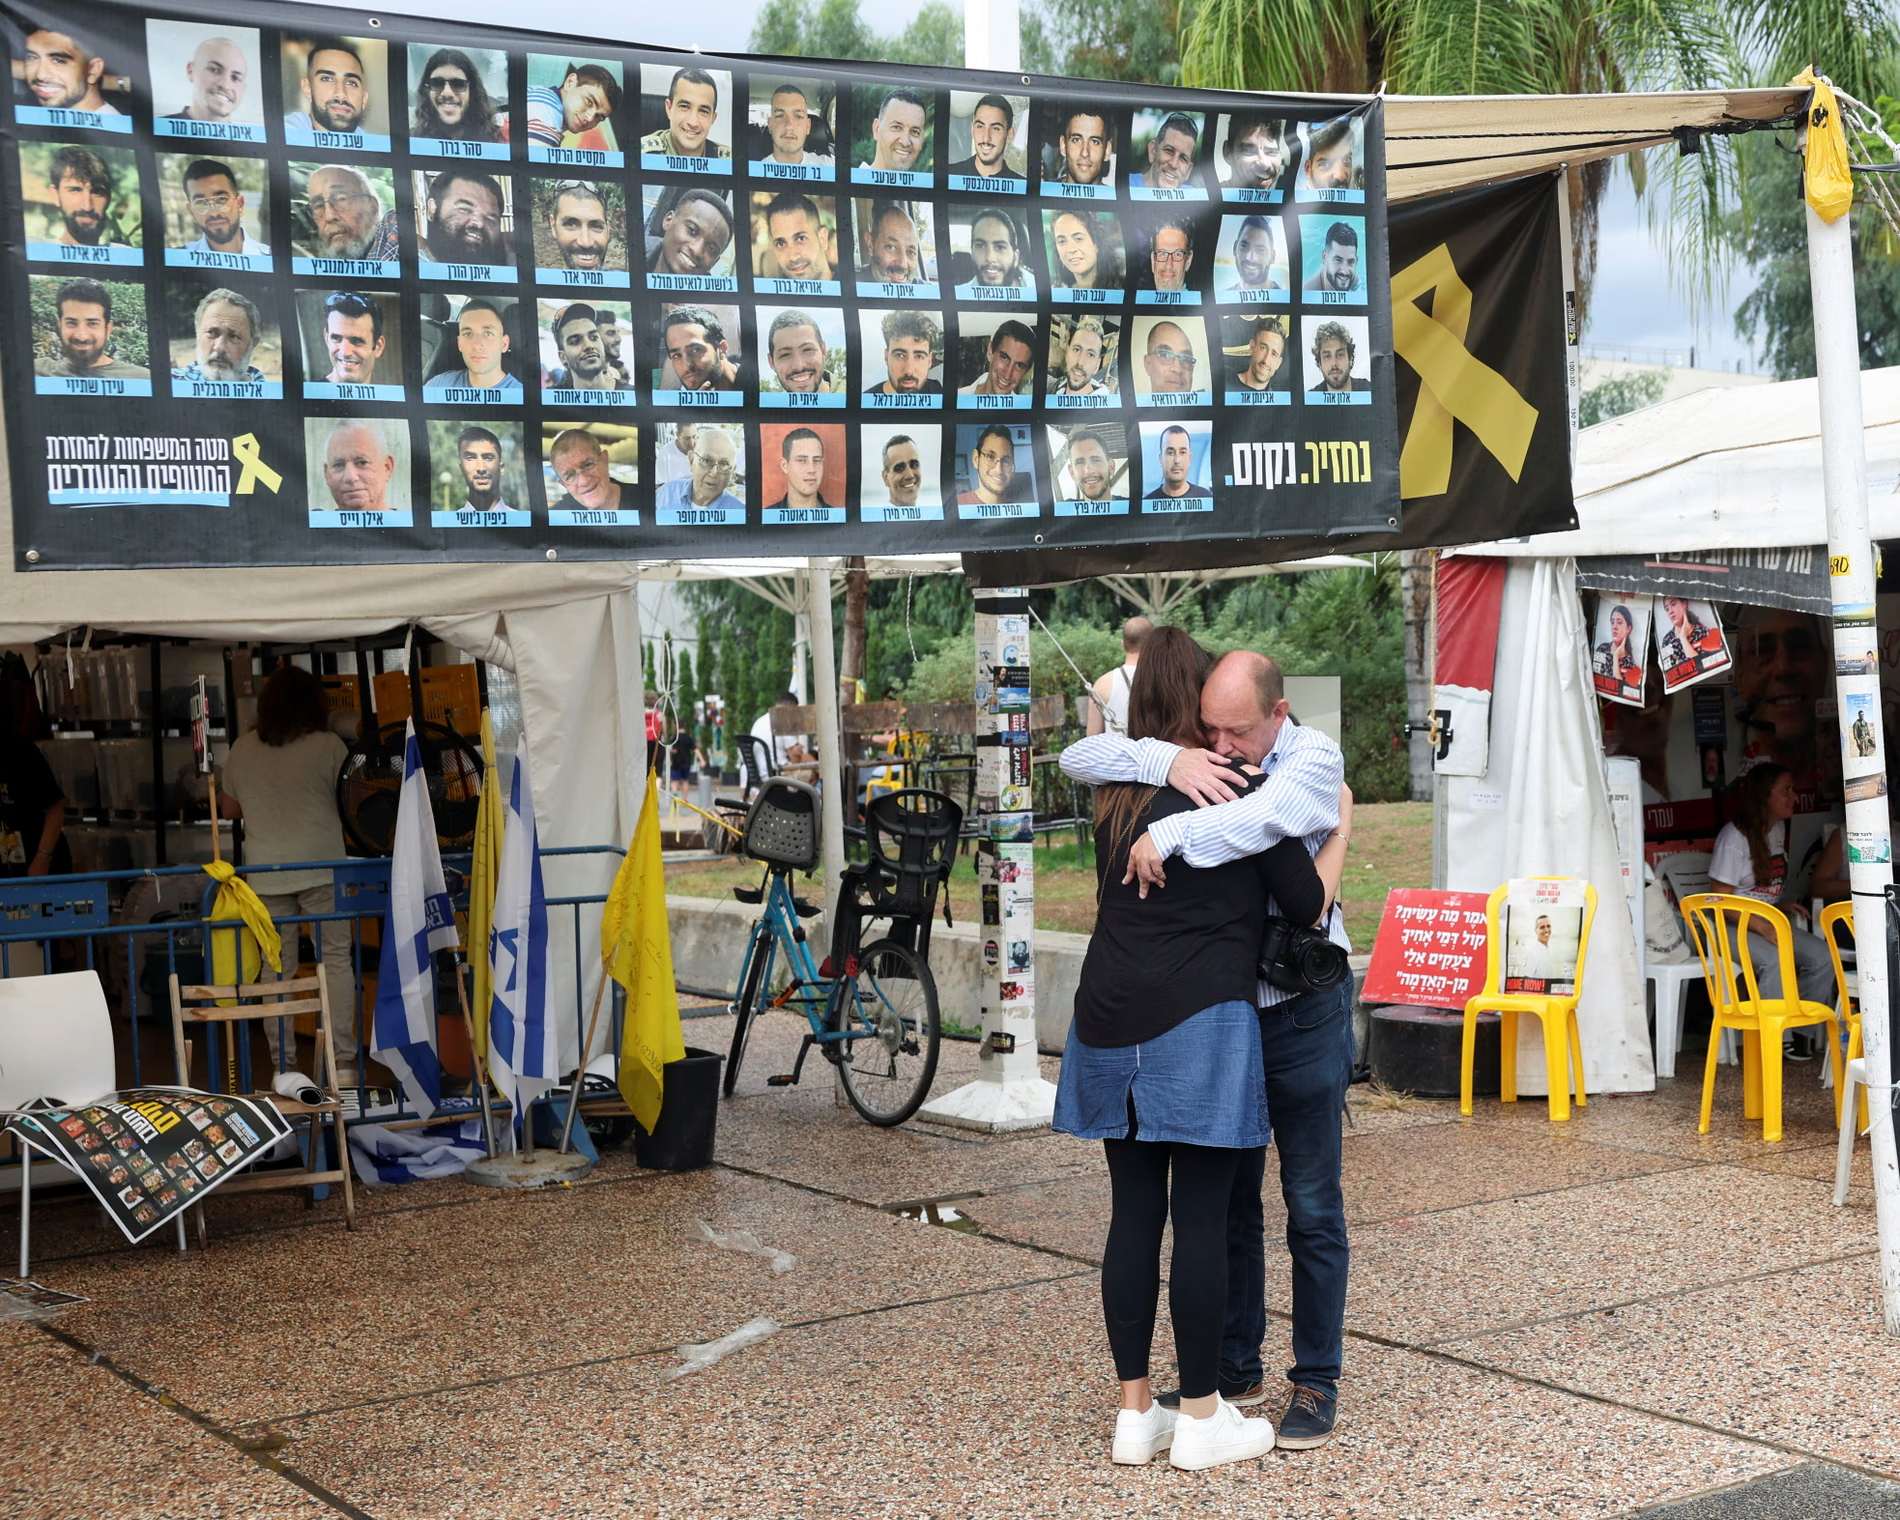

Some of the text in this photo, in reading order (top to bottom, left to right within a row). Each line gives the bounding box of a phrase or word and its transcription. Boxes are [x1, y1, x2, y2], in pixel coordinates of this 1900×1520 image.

[47, 109, 103, 128] אביתר דוד
[169, 120, 252, 140] איתן אברהם מור
[313, 131, 363, 149] שגב כלפון
[439, 141, 482, 157] סהר ברוך
[547, 148, 605, 165] מקסים הרקין
[666, 155, 708, 172] אסף חממי
[763, 163, 821, 180] בר קופרשטיין
[872, 171, 914, 186] יוסי שרעבי
[963, 177, 1014, 192] רום ברסלבסקי
[1061, 184, 1094, 197] עוז דניאל
[1319, 190, 1346, 202] דוד קוניו
[60, 245, 110, 262] גיא אילוז
[190, 250, 250, 270] רן רני גואילי
[311, 258, 382, 276] אריה זלמנוביץ
[448, 264, 490, 281] איתן הורן
[562, 271, 603, 285] תמיר אדר
[773, 279, 822, 294] אוריאל ברוך
[883, 283, 914, 298] איתן לוי
[972, 287, 1020, 301] מתן צנגאוקר
[1073, 289, 1105, 302] ענבר הימן
[1240, 290, 1270, 303] גלי ברמן
[1321, 291, 1347, 304] זיו ברמן
[66, 378, 124, 395] עידן שתיוי
[193, 381, 262, 397] אליהו מרגלית
[337, 385, 375, 399] דרור אור
[445, 386, 501, 403] מתן אנגרסט
[554, 390, 624, 405] יוסף חיים אוחנה
[679, 392, 718, 405] נמרוד כהן
[789, 393, 818, 407] איתי חן
[873, 393, 931, 407] גיא גלבוע דלאל
[977, 396, 1013, 408] הדר גולדין
[1058, 396, 1108, 408] אלקנה בוחבוט
[1152, 394, 1197, 406] ליאור רודאיף
[1241, 392, 1274, 404] אבינתן אור
[1323, 391, 1350, 403] אלון אהל
[46, 434, 229, 461] מטה המשפחות להחזרת
[48, 464, 231, 494] החטופים והנעדרים
[978, 505, 1022, 517] תמיר נמרודי
[1075, 501, 1110, 514] דניאל פרץ
[1153, 499, 1202, 511] מחמד אלאטרש
[340, 512, 383, 527] אילן וייס
[456, 512, 507, 526] ביפין ג'ושי
[571, 511, 617, 524] מני גודארד
[676, 509, 726, 524] עמירם קופר
[780, 508, 829, 522] עומר נאוטרה
[884, 508, 921, 521] עמרי מירן
[1648, 808, 1673, 829] עמרי
